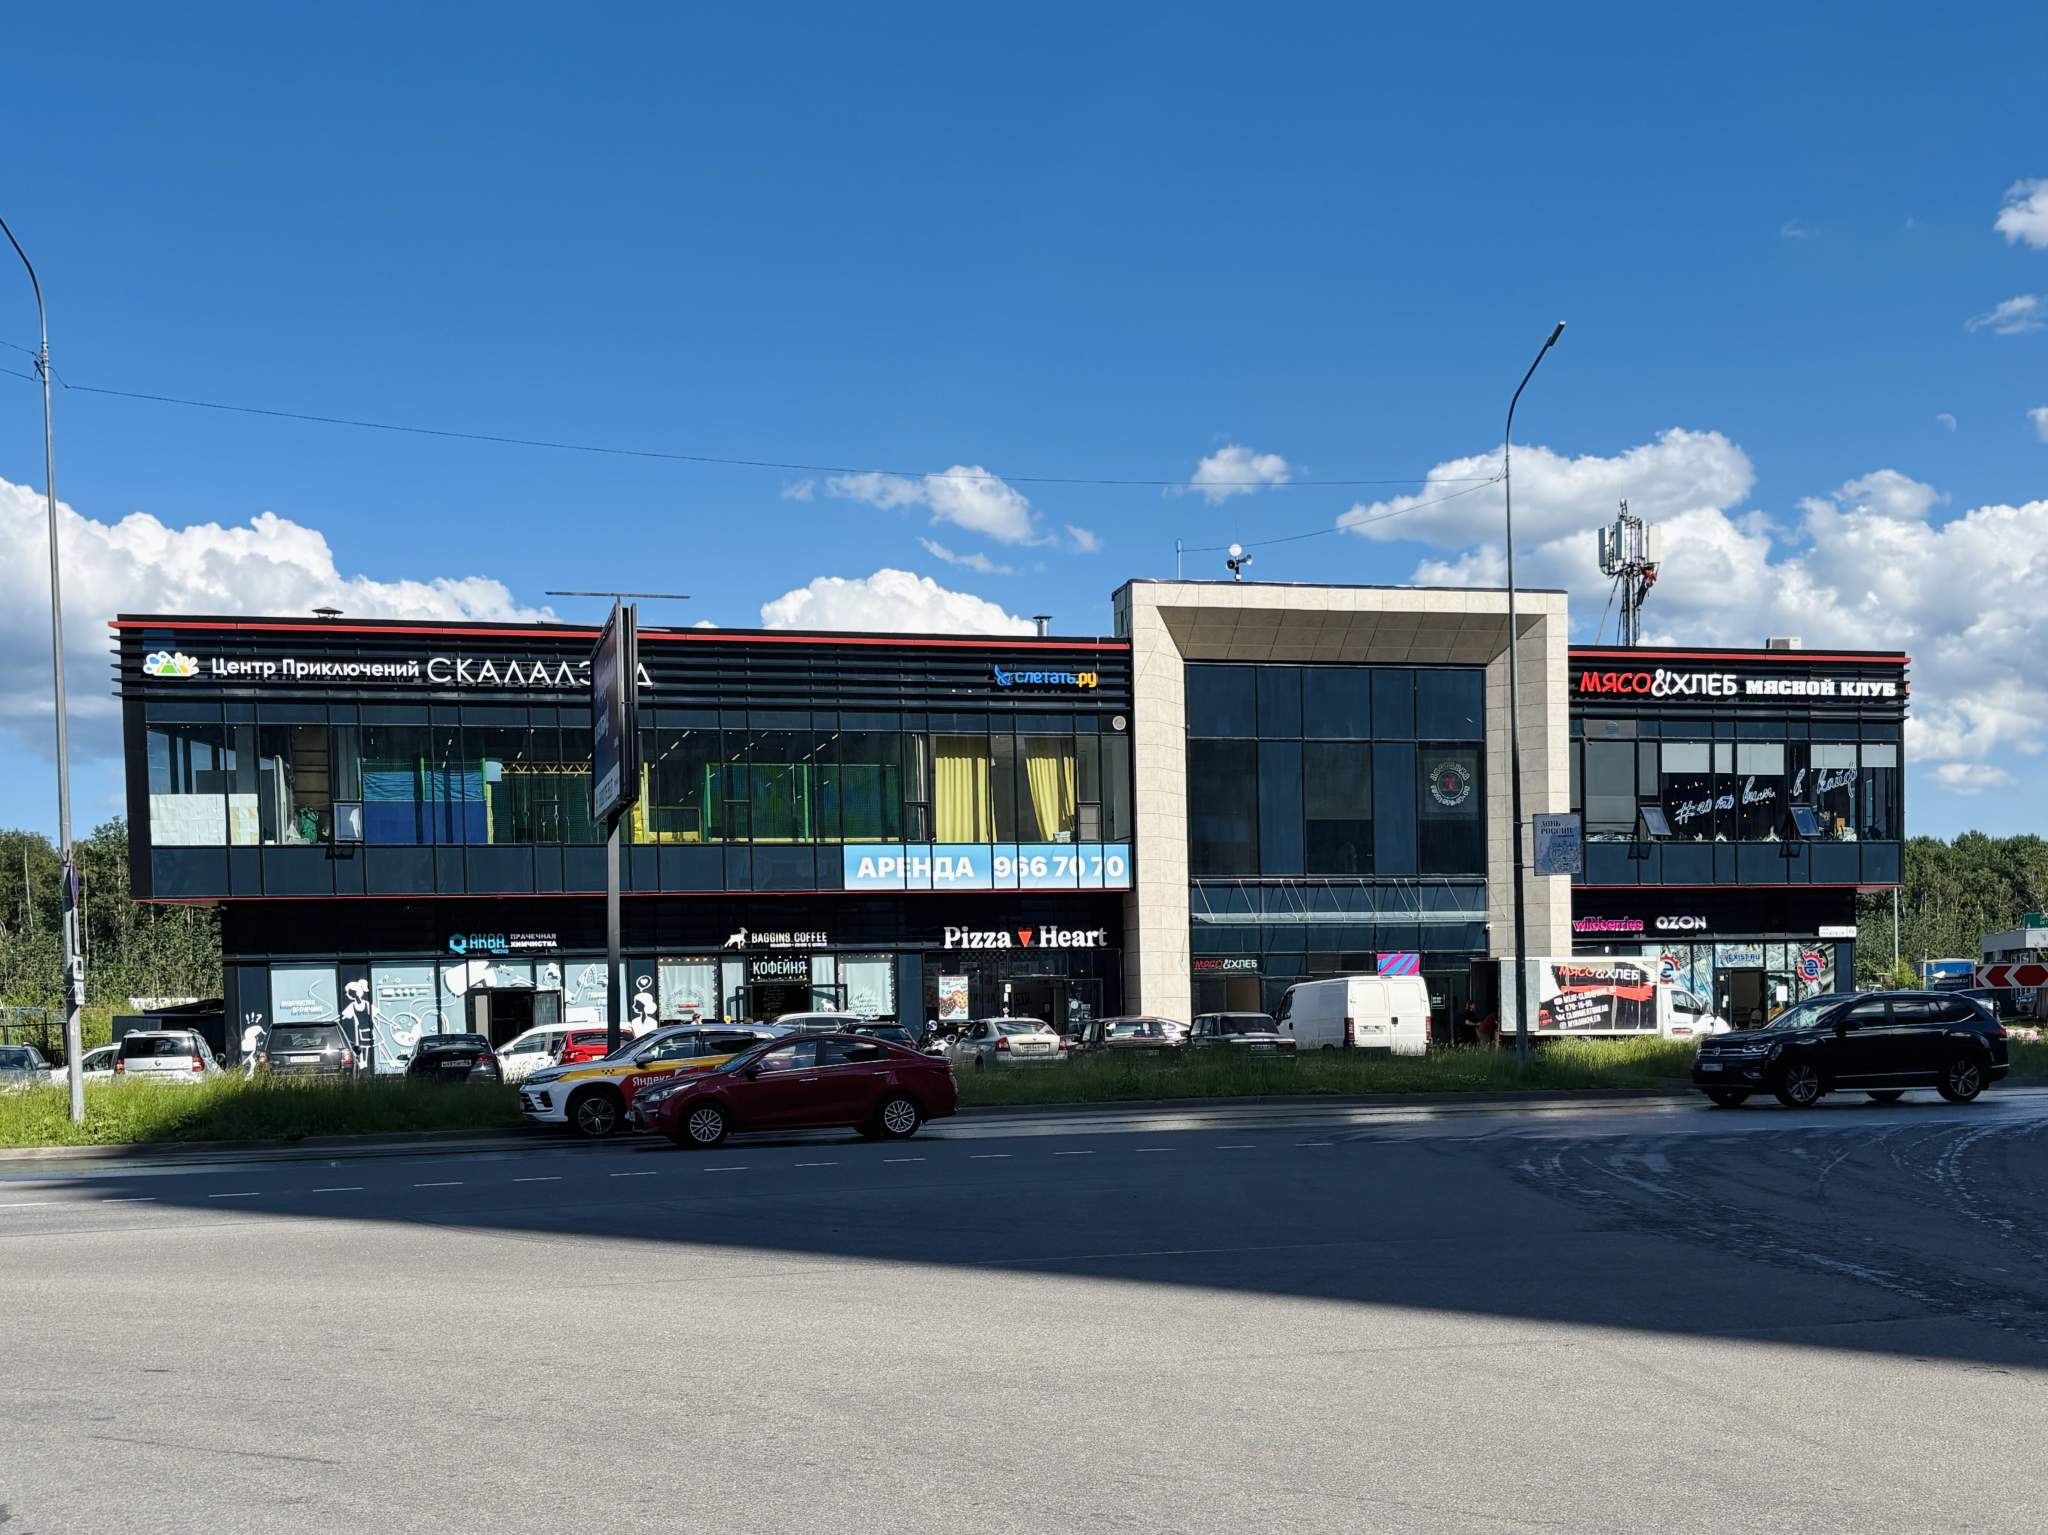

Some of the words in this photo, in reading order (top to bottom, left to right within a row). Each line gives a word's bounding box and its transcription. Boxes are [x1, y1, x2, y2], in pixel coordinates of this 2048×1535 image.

[211, 657, 276, 675] Центр
[282, 658, 420, 677] Приключений
[426, 657, 654, 686] СКАЛАЛЭД
[1015, 670, 1098, 688] слетать.ру
[1580, 668, 1737, 697] МЯСО&ХЛЕБ
[1745, 678, 1837, 696] МЯСНОЙ
[1840, 679, 1897, 697] КЛУБ
[856, 856, 976, 881] АРЕНДА
[994, 856, 1048, 878] 966
[1052, 856, 1086, 877] 70
[1091, 855, 1125, 877] 70
[1572, 915, 1644, 932] wildberries
[1655, 915, 1707, 931] OZON
[510, 933, 557, 941] ПРАЧЕЧНАЯ
[510, 940, 558, 948] ХИМЧИСТКА
[751, 932, 791, 944] BAGGINS
[793, 931, 828, 943] COFFEE
[943, 926, 1012, 950] Pizza
[1039, 926, 1108, 948] Heart
[752, 959, 807, 975] КОФЕЙНЯ
